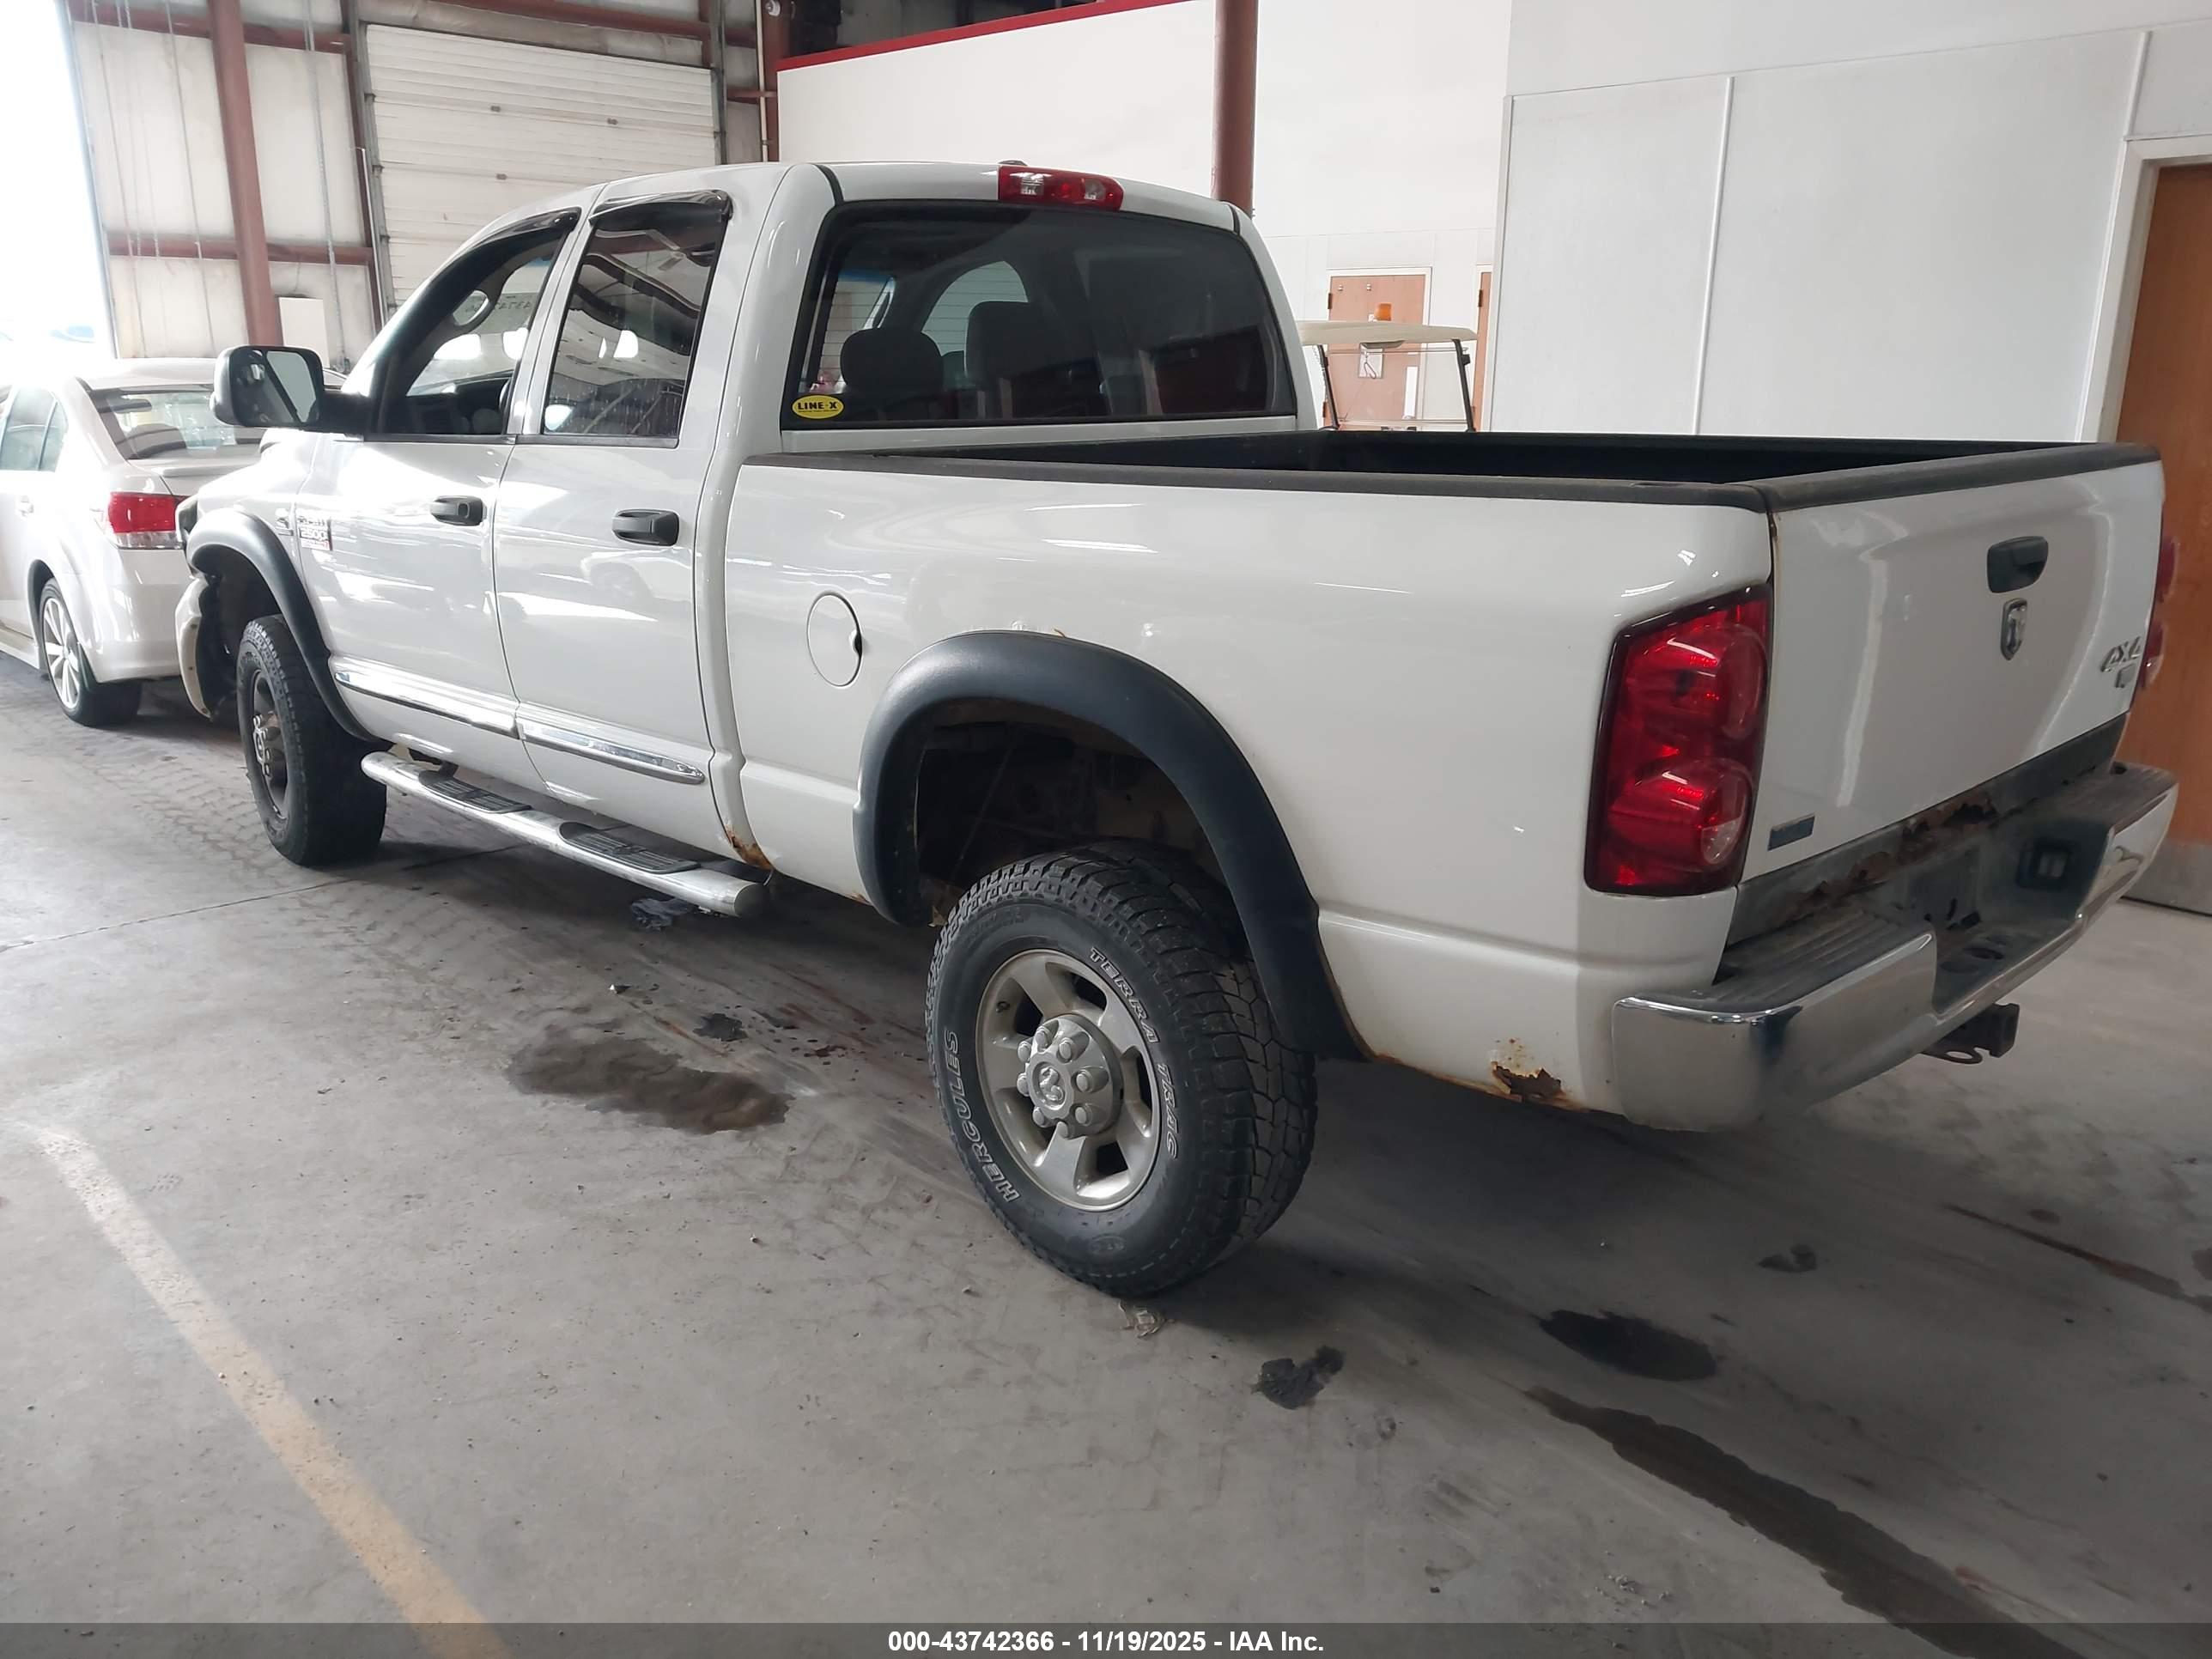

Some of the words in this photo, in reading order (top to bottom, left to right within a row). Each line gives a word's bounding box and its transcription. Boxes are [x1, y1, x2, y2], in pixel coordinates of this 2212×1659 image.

[945, 1030, 1020, 1202] HERCULES
[1091, 947, 1159, 1043] TERRA
[1157, 1063, 1178, 1159] TRAC
